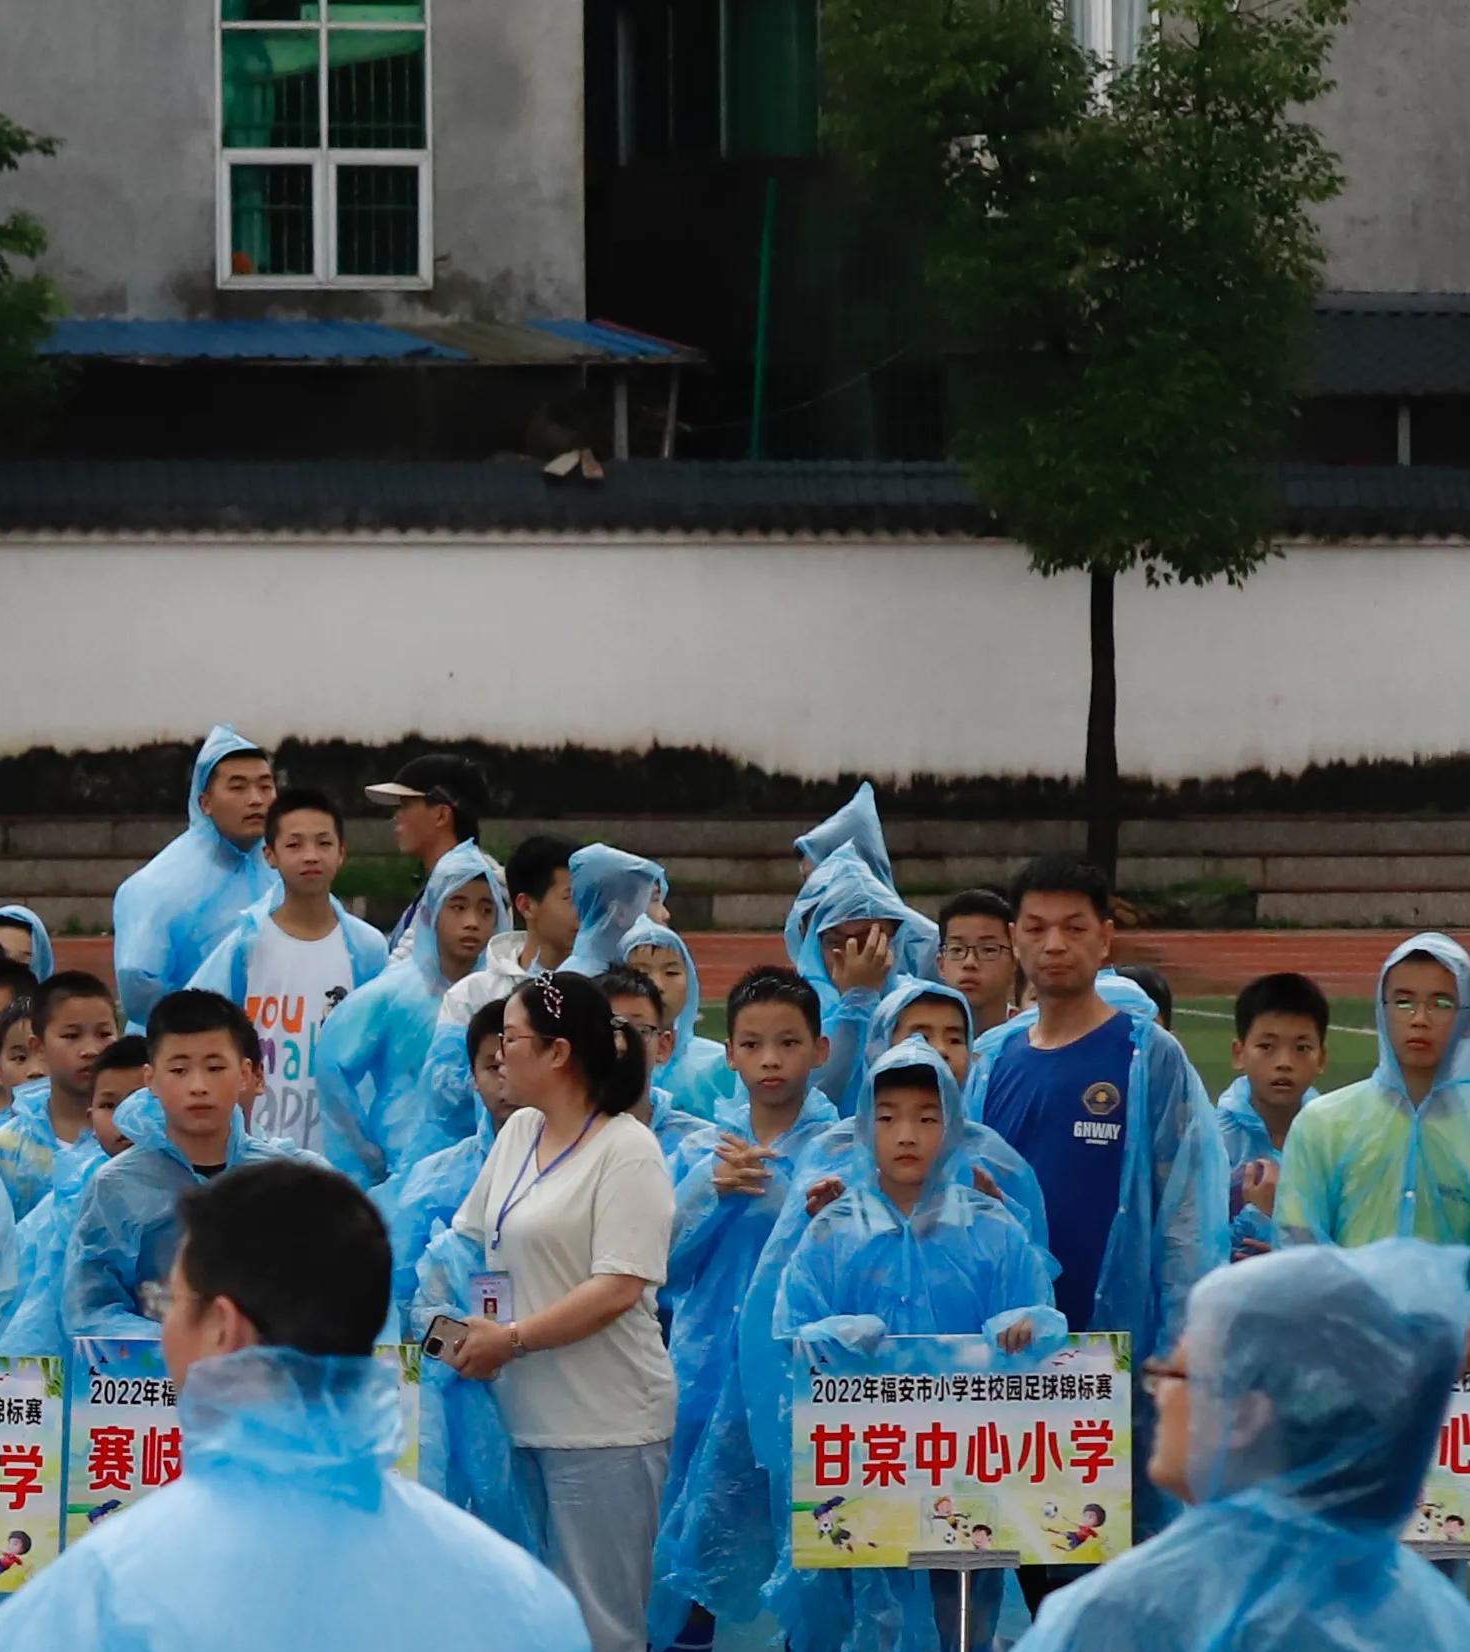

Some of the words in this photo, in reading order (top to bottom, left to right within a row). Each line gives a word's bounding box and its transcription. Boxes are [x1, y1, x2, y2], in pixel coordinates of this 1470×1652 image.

[812, 1374, 1113, 1405] 2022年福安市小学生校园足球锦标赛
[810, 1420, 1114, 1487] 甘棠中心小学
